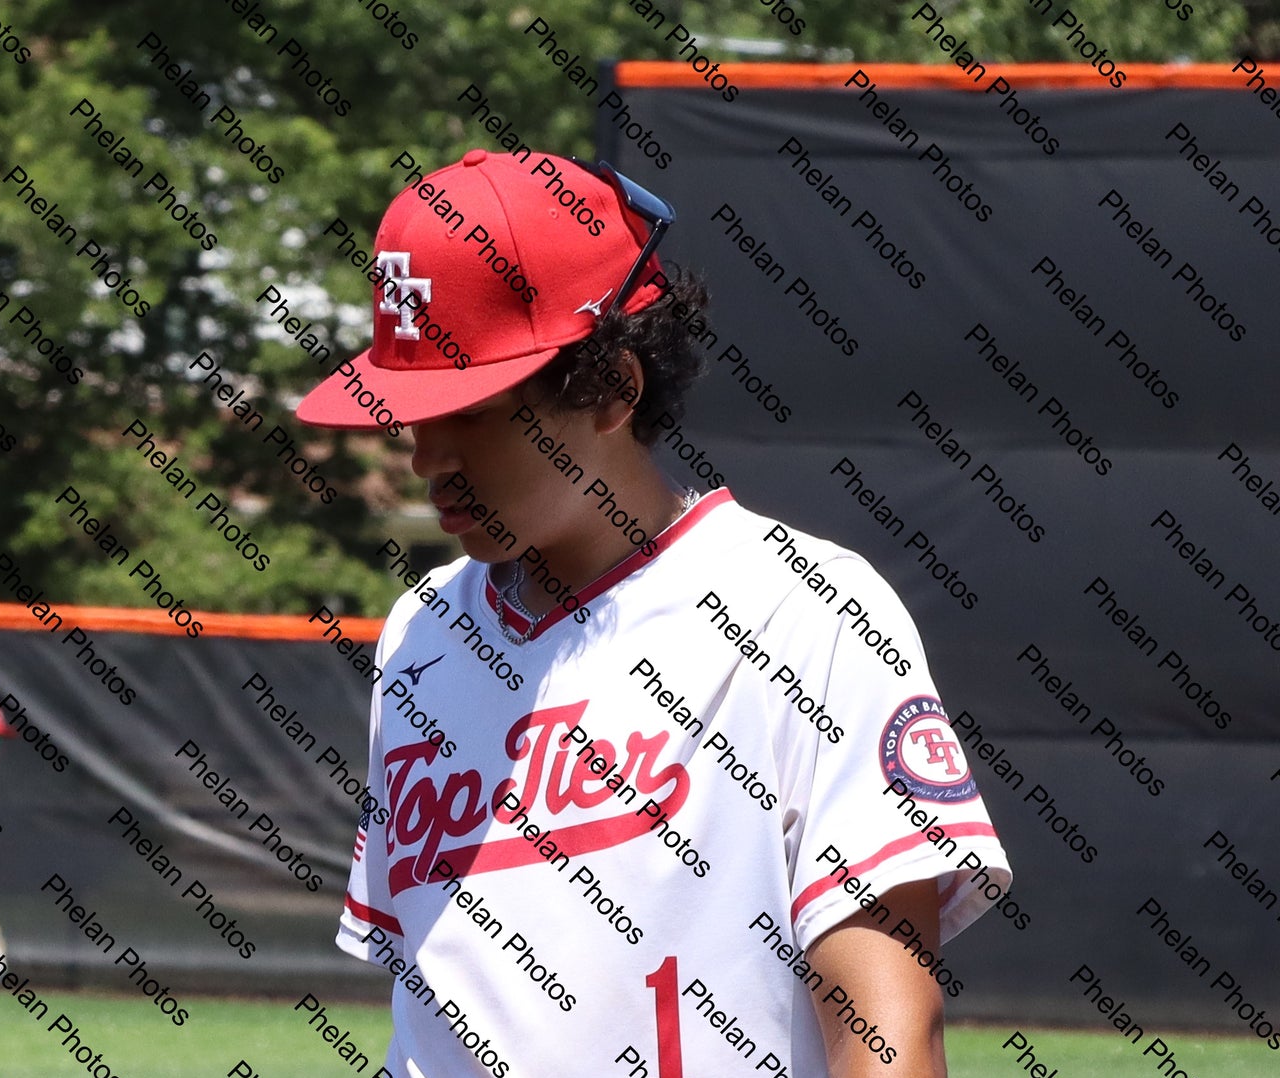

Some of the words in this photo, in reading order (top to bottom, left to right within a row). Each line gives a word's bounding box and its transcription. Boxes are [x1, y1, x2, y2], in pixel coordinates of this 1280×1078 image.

[886, 730, 898, 757] TOP
[894, 704, 920, 727] TIER
[384, 734, 488, 884] Top
[491, 699, 676, 825] Tier
